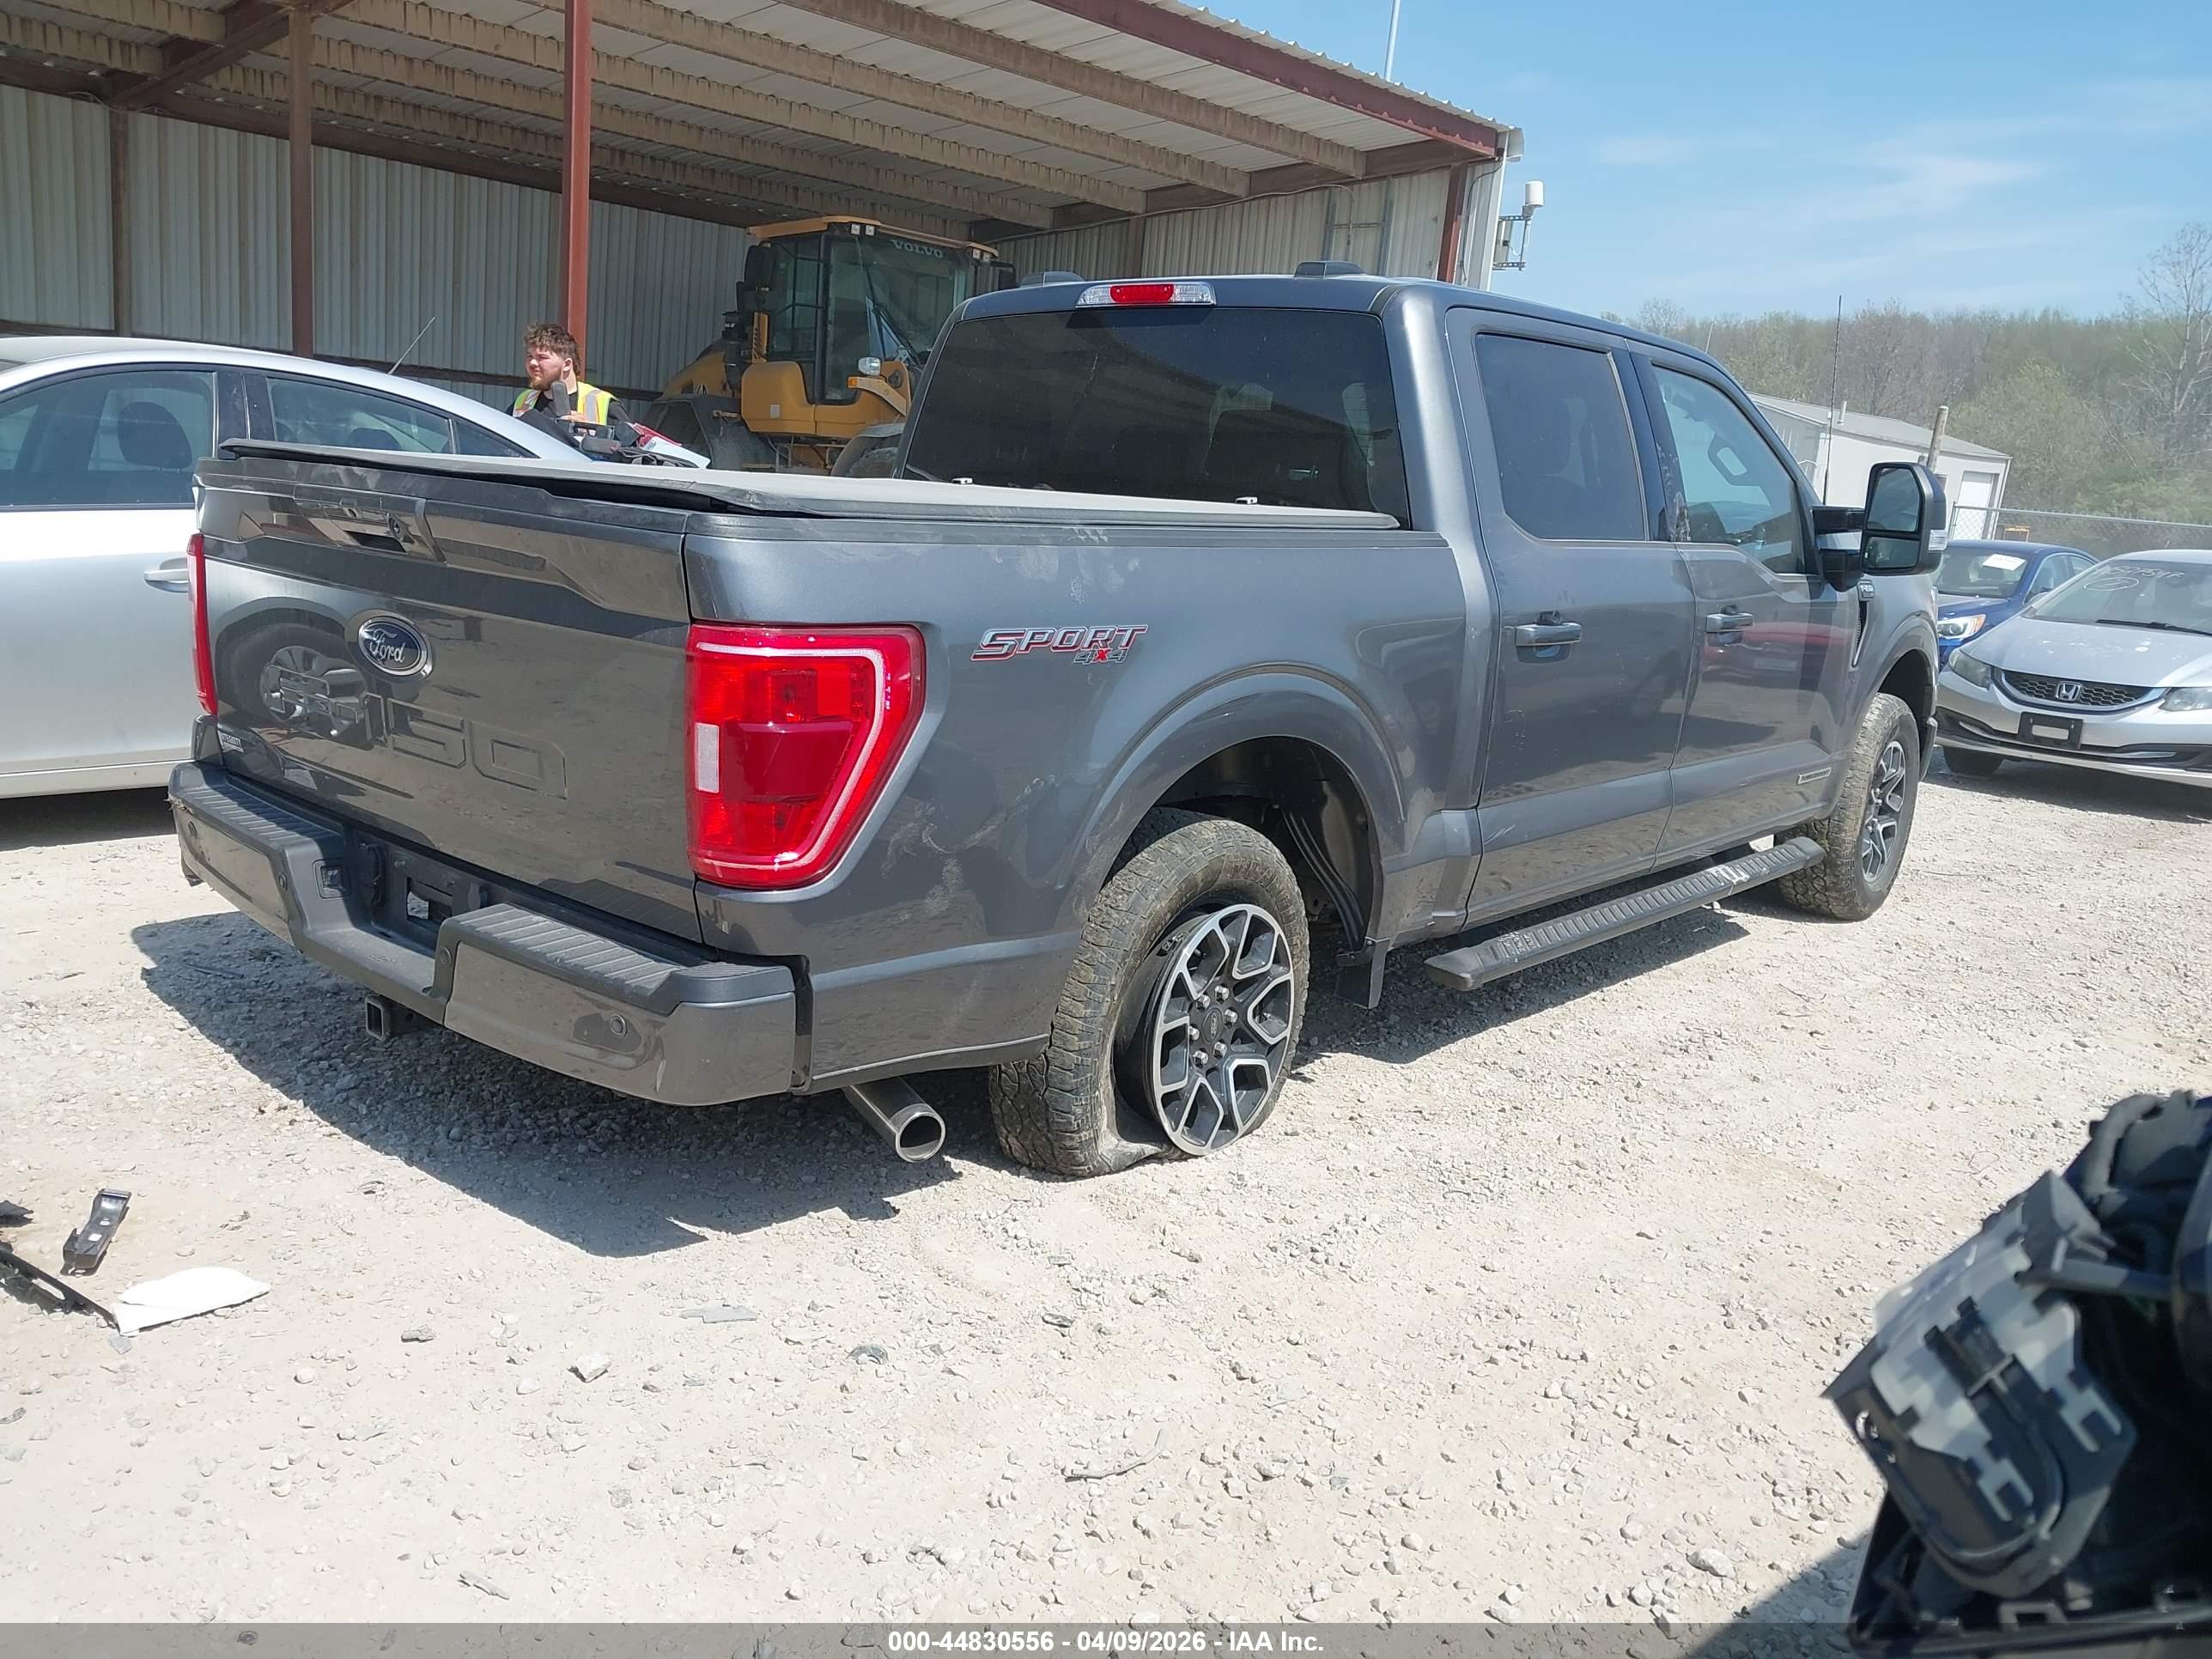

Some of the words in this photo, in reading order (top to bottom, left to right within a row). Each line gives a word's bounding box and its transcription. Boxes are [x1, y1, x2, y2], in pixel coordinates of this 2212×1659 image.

[890, 239, 944, 258] VOLVO
[369, 628, 405, 663] Ford
[971, 625, 1148, 660] SPORT
